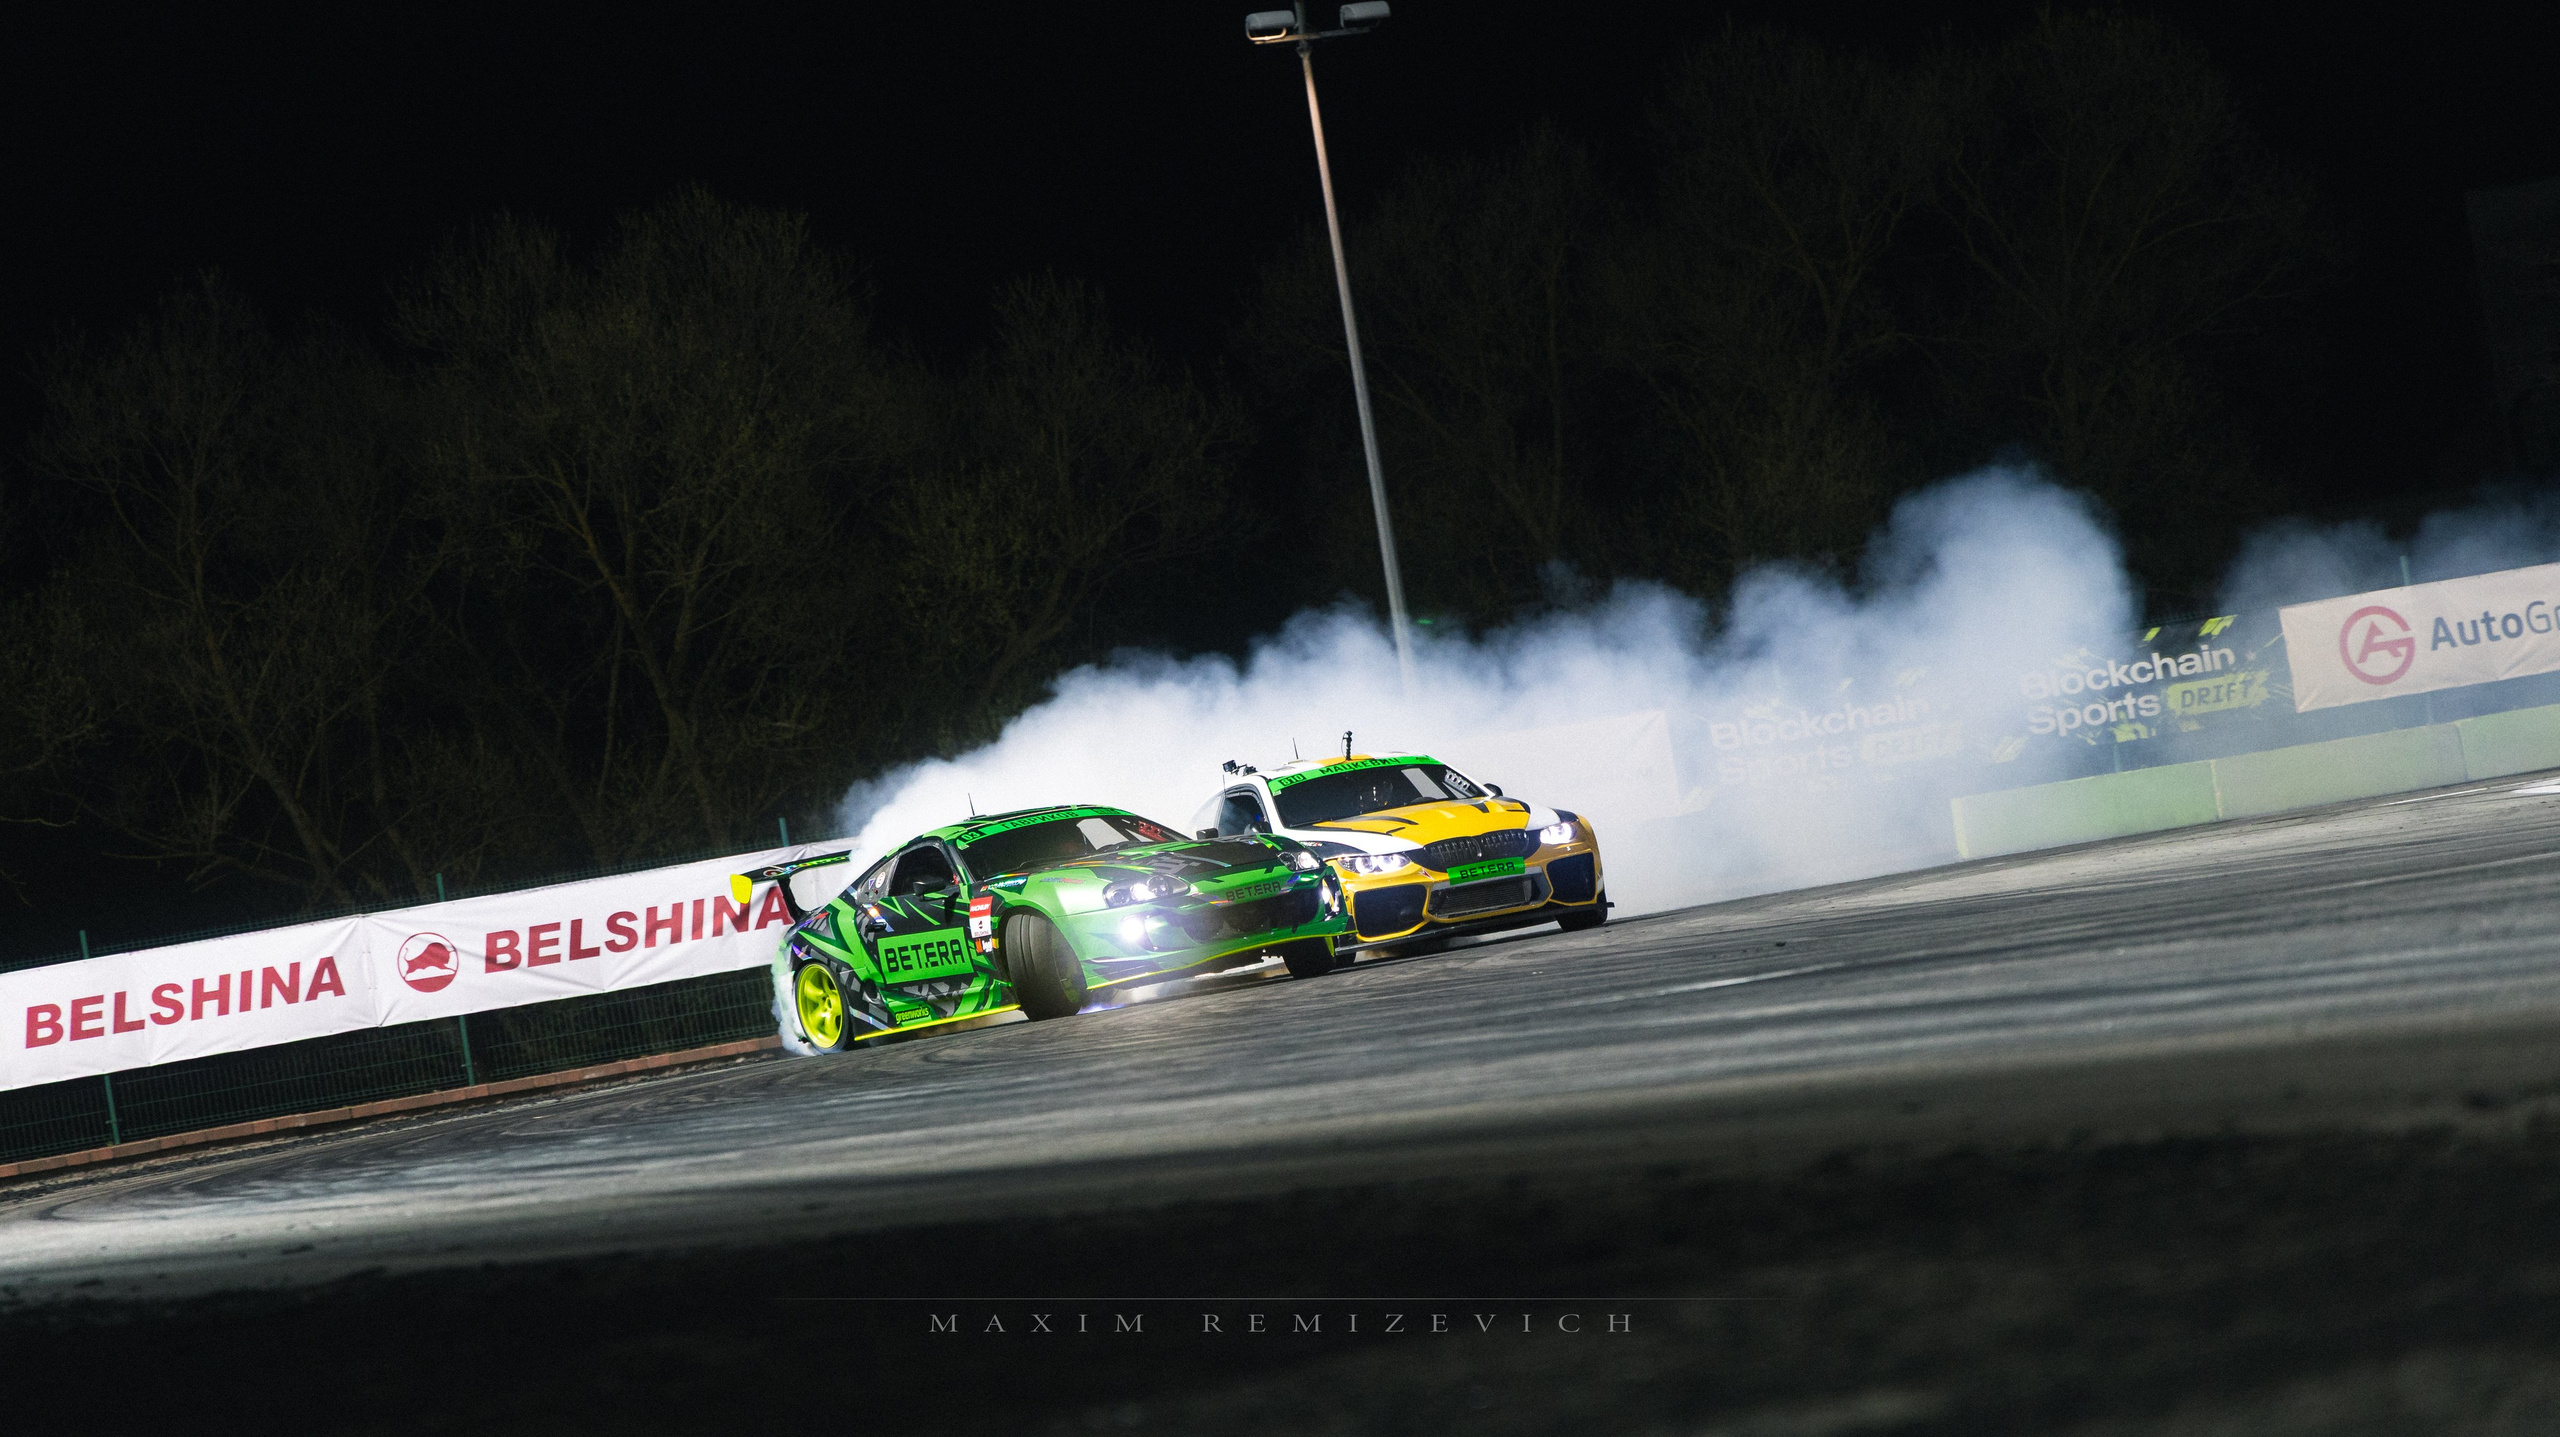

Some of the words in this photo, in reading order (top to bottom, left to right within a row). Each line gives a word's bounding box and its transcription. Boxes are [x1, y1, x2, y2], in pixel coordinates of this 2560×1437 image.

[2020, 644, 2236, 699] Blockchain
[2027, 691, 2162, 737] Sports
[2180, 679, 2255, 709] DRIFT
[1319, 757, 1401, 775] МАЦКЕВИЧ
[961, 831, 982, 842] 03
[1459, 860, 1516, 880] BETERA
[1225, 880, 1282, 900] BETERA
[484, 886, 795, 975] BELSHINA
[884, 938, 966, 973] BETERA
[25, 956, 347, 1049] BELSHINA
[895, 1006, 930, 1025] greenworks
